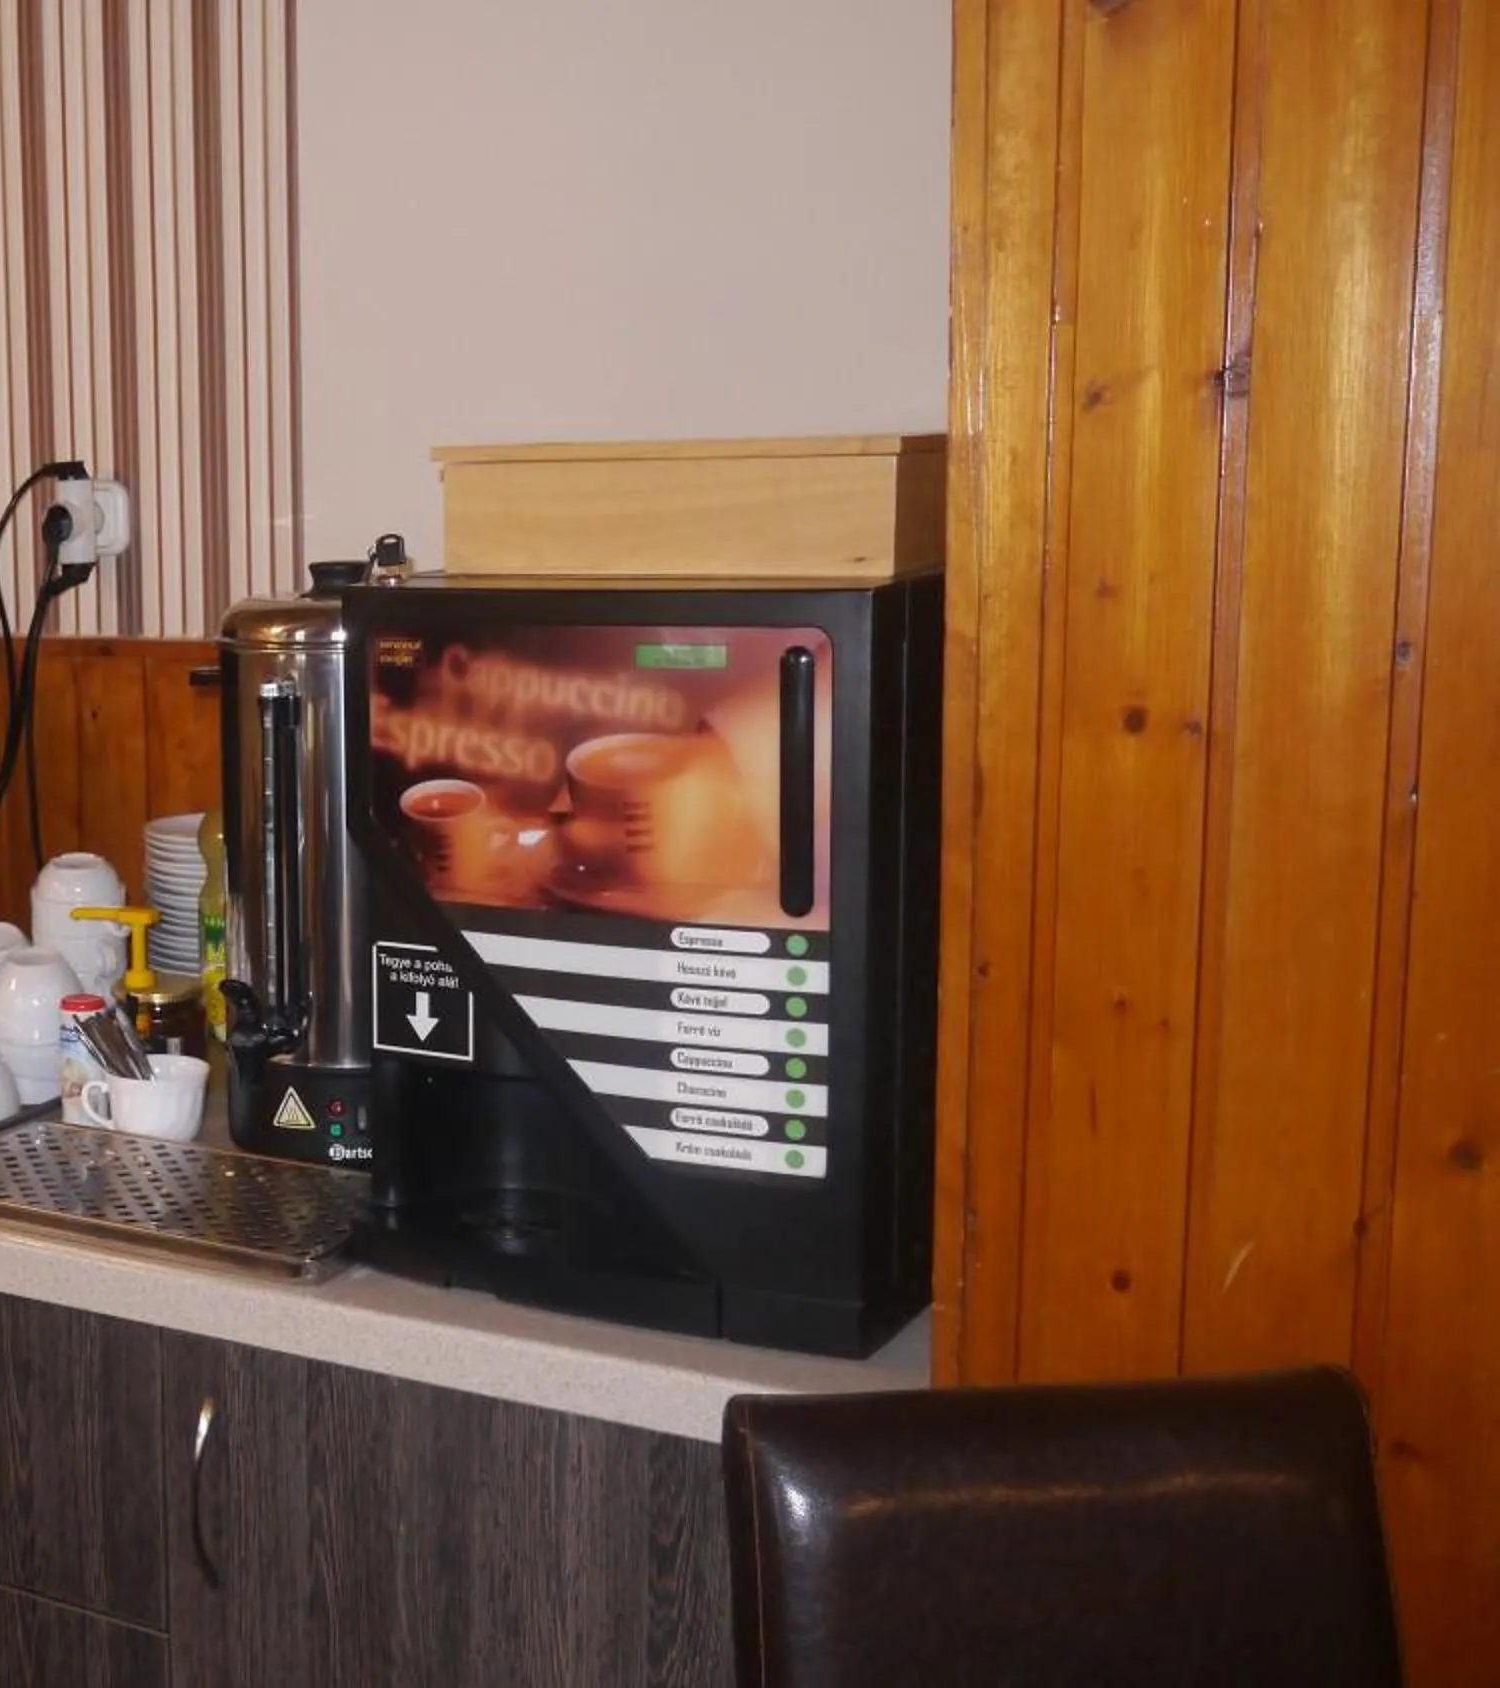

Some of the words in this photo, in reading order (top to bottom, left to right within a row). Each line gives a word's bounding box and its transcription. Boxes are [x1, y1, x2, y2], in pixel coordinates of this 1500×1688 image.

[441, 645, 686, 729] Cappuccino
[679, 931, 723, 947] Espresso
[378, 953, 412, 969] Tegye
[413, 959, 422, 969] a
[389, 971, 398, 982] a
